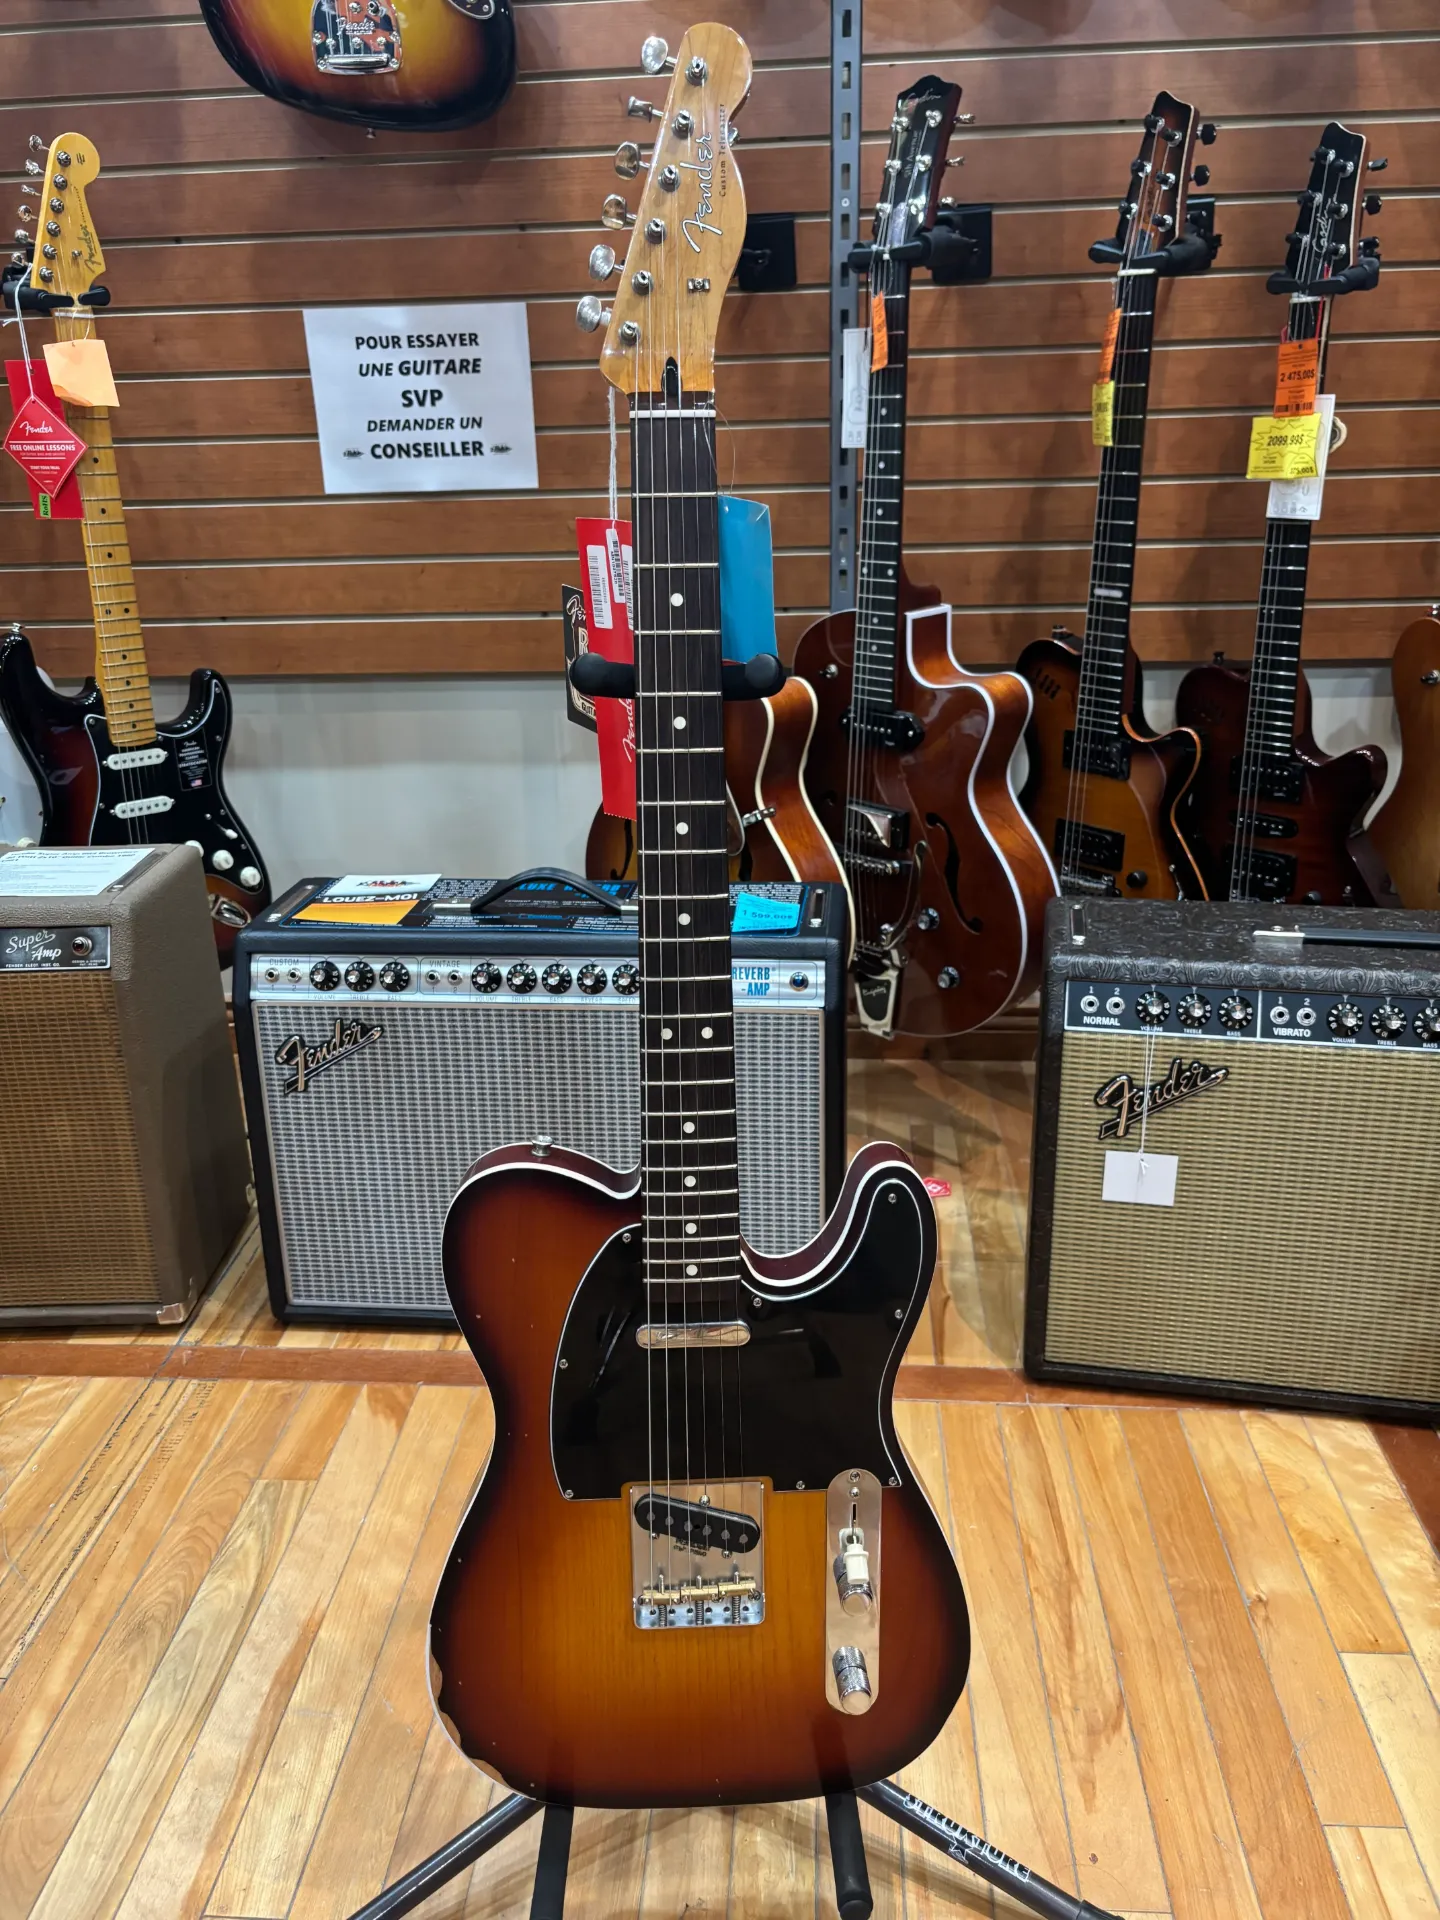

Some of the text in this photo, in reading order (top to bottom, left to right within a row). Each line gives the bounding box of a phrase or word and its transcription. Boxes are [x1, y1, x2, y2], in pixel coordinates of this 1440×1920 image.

[718, 103, 726, 197] Custom Telecaster
[679, 131, 723, 253] Fender
[77, 223, 102, 274] Fender
[355, 332, 480, 350] POUR ESSAYER
[358, 358, 482, 377] UNE GUITARE
[400, 388, 444, 408] SVP
[19, 420, 54, 437] Fender
[366, 416, 483, 432] DEMANDER UN
[370, 440, 485, 460] CONSEILLER
[322, 893, 419, 903] LOUEZ-MOI
[5, 929, 57, 953] Super
[269, 958, 300, 966] CUSTOM
[429, 960, 461, 968] VINTAGE
[732, 966, 770, 981] REVERB
[1083, 1015, 1121, 1026] NORMAL
[1272, 1027, 1312, 1037] VIBRATO
[275, 1018, 384, 1095] Fender
[1094, 1057, 1229, 1139] Fender
